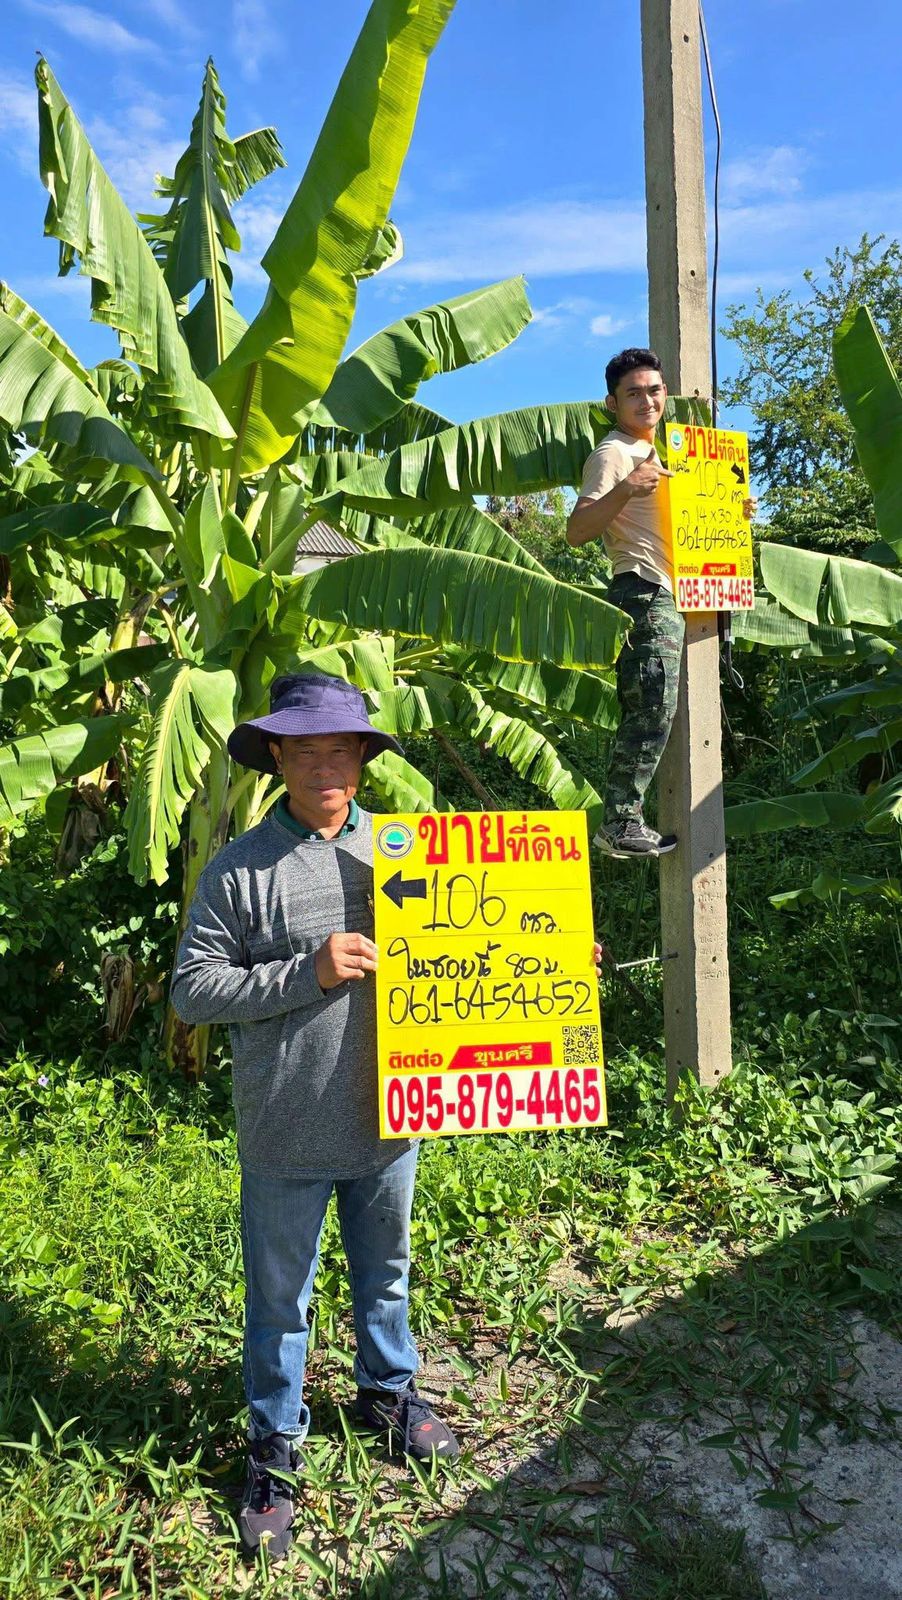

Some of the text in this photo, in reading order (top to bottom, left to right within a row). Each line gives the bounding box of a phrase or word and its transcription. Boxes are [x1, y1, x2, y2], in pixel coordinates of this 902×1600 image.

[685, 426, 746, 462] ขายที่ดิน
[694, 461, 727, 501] 106
[677, 525, 749, 552] 061-6454652
[679, 563, 731, 575] ติดต่อ ขุนศรี
[679, 578, 752, 609] 095-879-4465
[418, 813, 582, 865] ขายที่ดิน
[422, 869, 506, 931] 106
[387, 937, 502, 979] ในซอยนี้
[388, 979, 593, 1024] 061-6454652
[389, 1044, 534, 1069] ติดต่อ ขุนศรี
[387, 1068, 601, 1134] 095-879-4465
